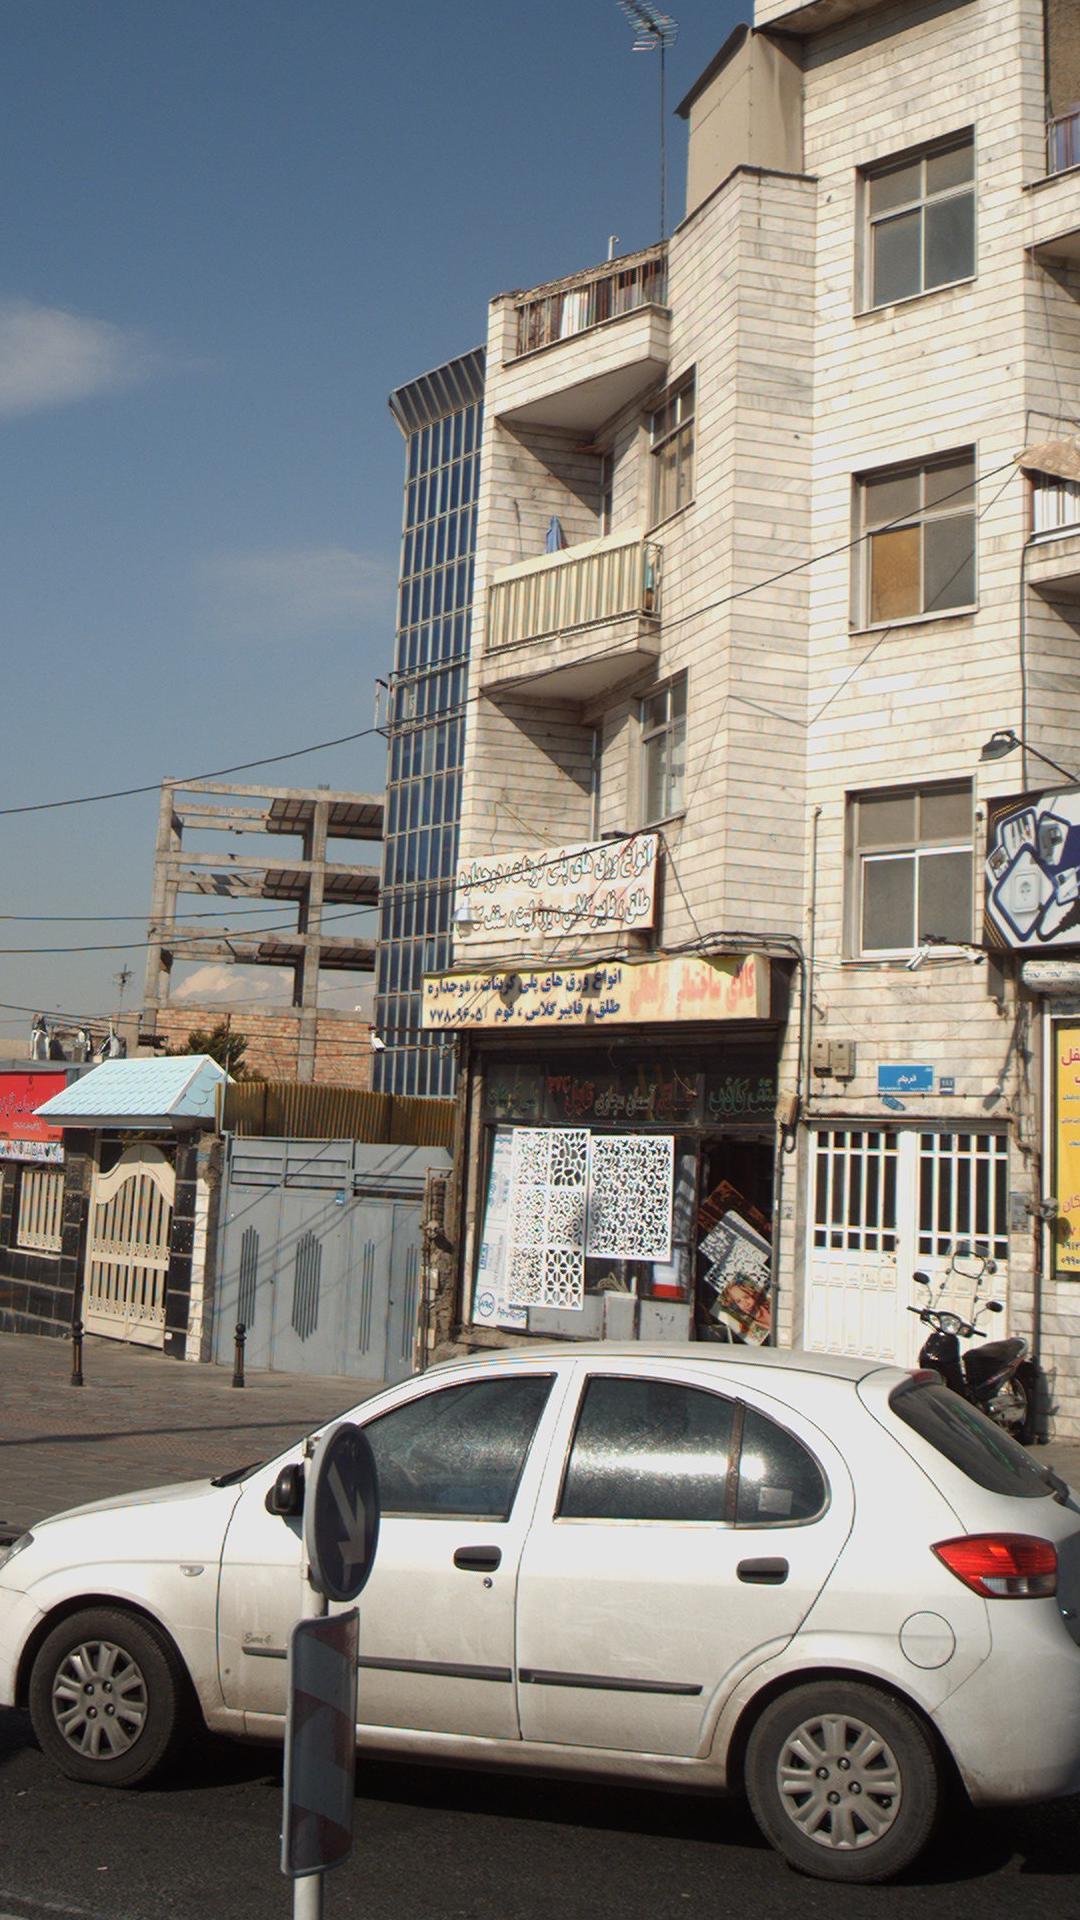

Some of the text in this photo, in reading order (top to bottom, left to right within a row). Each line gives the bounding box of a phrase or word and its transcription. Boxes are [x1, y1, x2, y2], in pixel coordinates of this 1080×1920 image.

[569, 847, 593, 884] های
[594, 850, 619, 881] ورق
[620, 839, 653, 879] انواع
[519, 973, 537, 994] پلی
[541, 971, 562, 992] های
[566, 972, 590, 992] ورق
[592, 967, 622, 990] انواع
